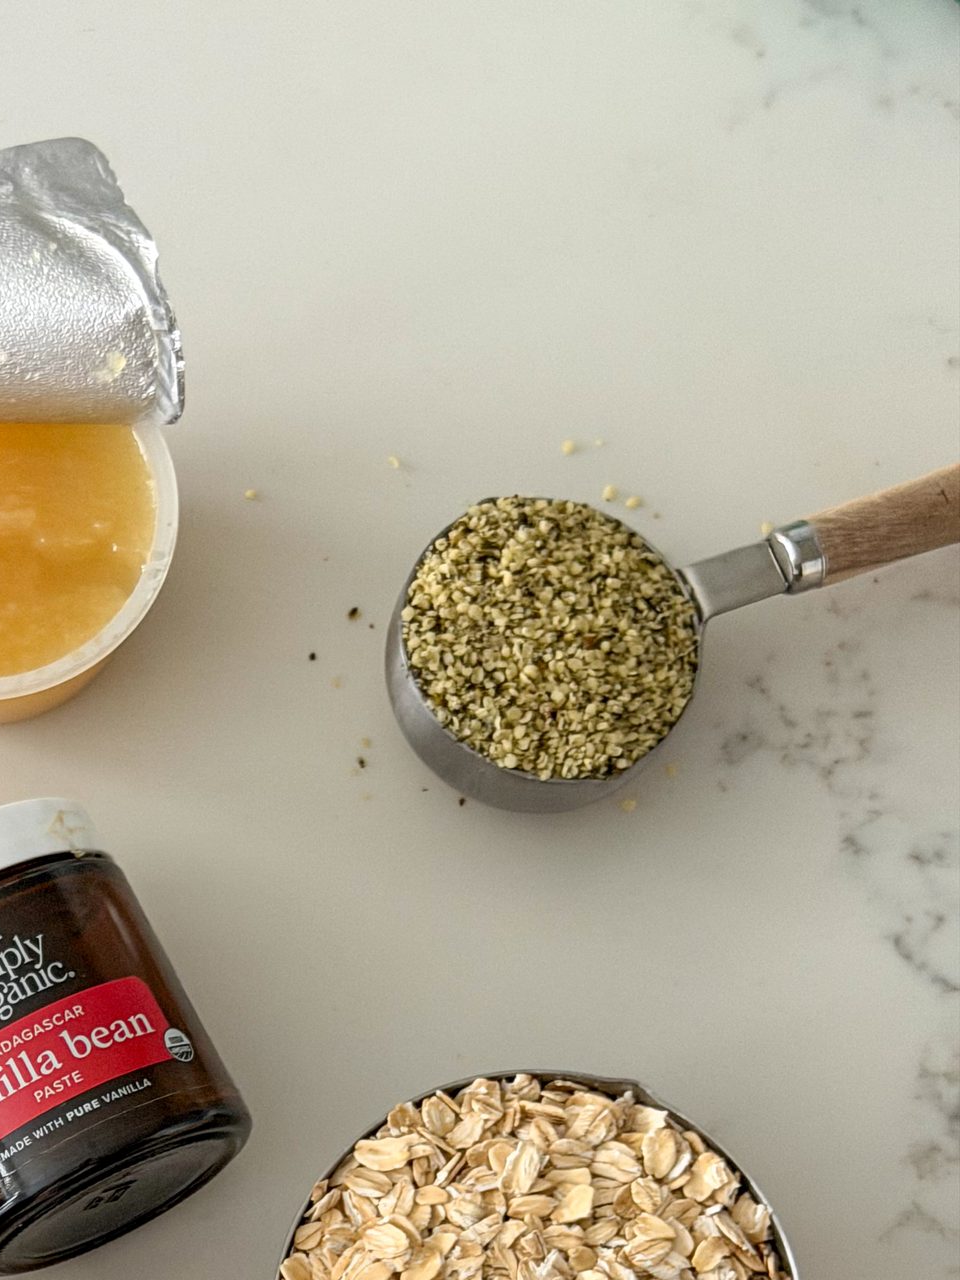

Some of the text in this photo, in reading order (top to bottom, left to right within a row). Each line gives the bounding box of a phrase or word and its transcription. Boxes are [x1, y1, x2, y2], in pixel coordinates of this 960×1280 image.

[59, 1012, 156, 1060] bean
[33, 1070, 85, 1103] PASTE
[0, 1078, 152, 1161] MADE WITH PURE VANILLA
